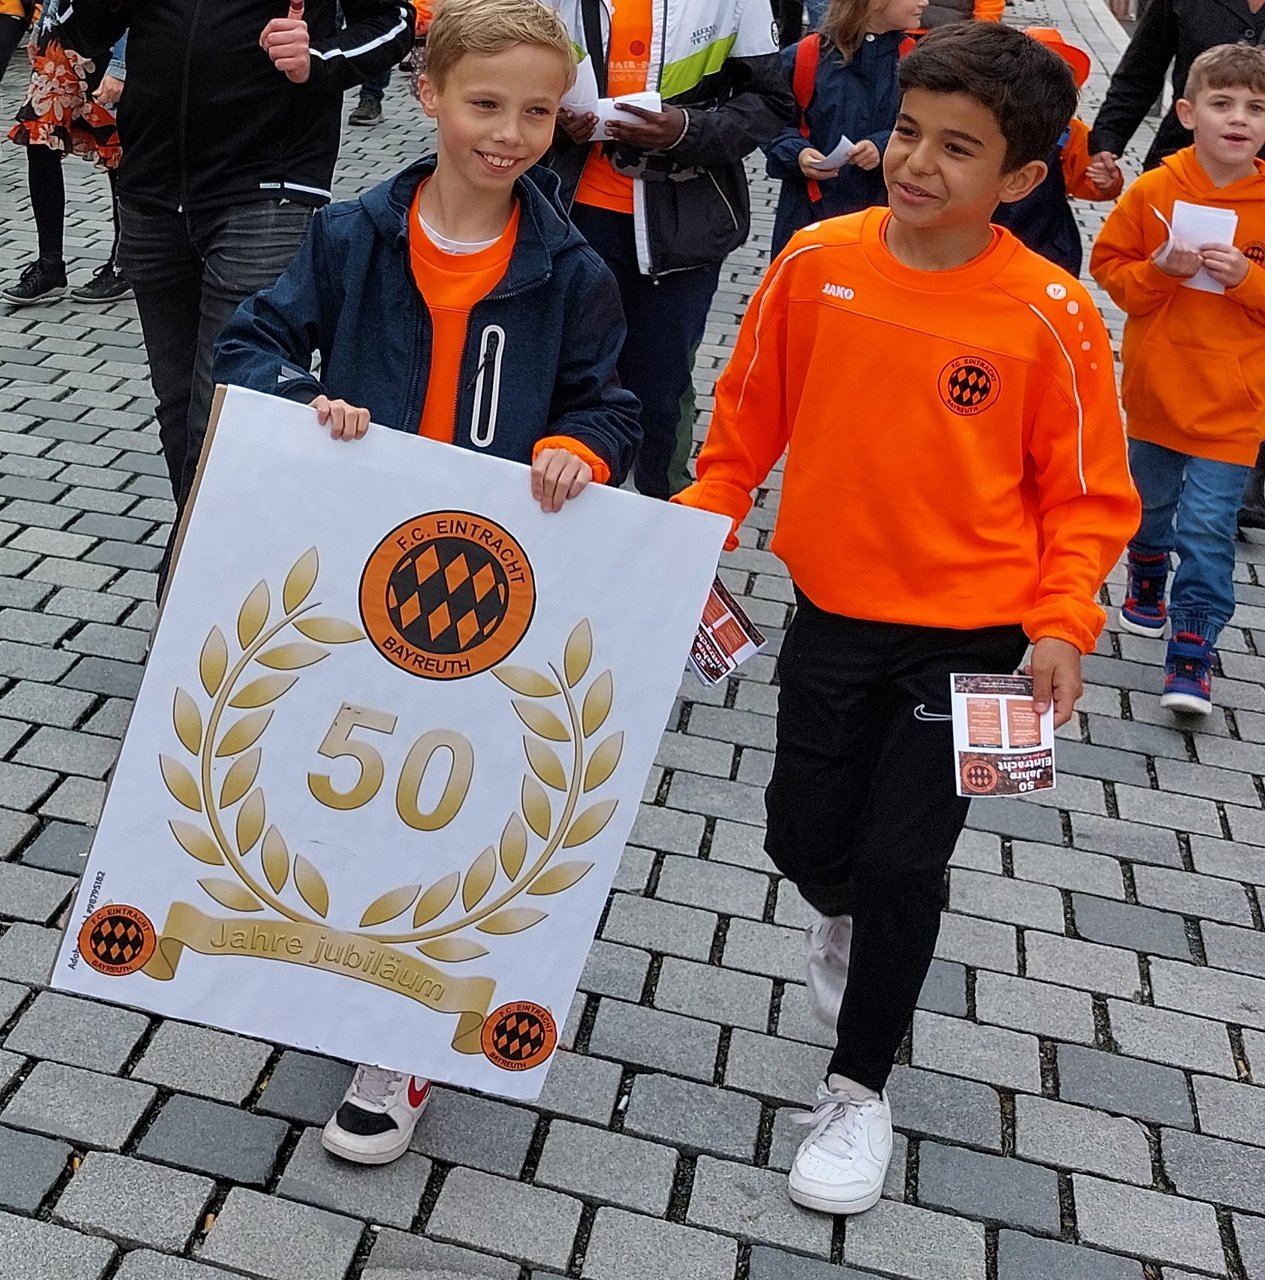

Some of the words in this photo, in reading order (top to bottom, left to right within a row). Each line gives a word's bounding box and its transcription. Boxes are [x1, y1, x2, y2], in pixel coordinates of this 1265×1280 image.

[821, 282, 855, 301] JAKO
[396, 527, 431, 552] F.C.
[436, 519, 526, 584] EINTRACHT
[382, 636, 472, 674] BAYREUTH
[307, 701, 475, 831] 50
[997, 756, 1052, 771] Eintracht
[1009, 768, 1043, 781] Jahre
[1018, 781, 1035, 792] 50
[107, 908, 151, 932] EINTRACHT
[68, 945, 80, 970] Adob
[91, 959, 133, 973] BAYREUTH
[209, 923, 304, 955] Jahre
[309, 935, 446, 1003] jubiläum
[516, 1004, 553, 1034] EINTRACHT
[488, 1051, 527, 1069] BAYREUTH
